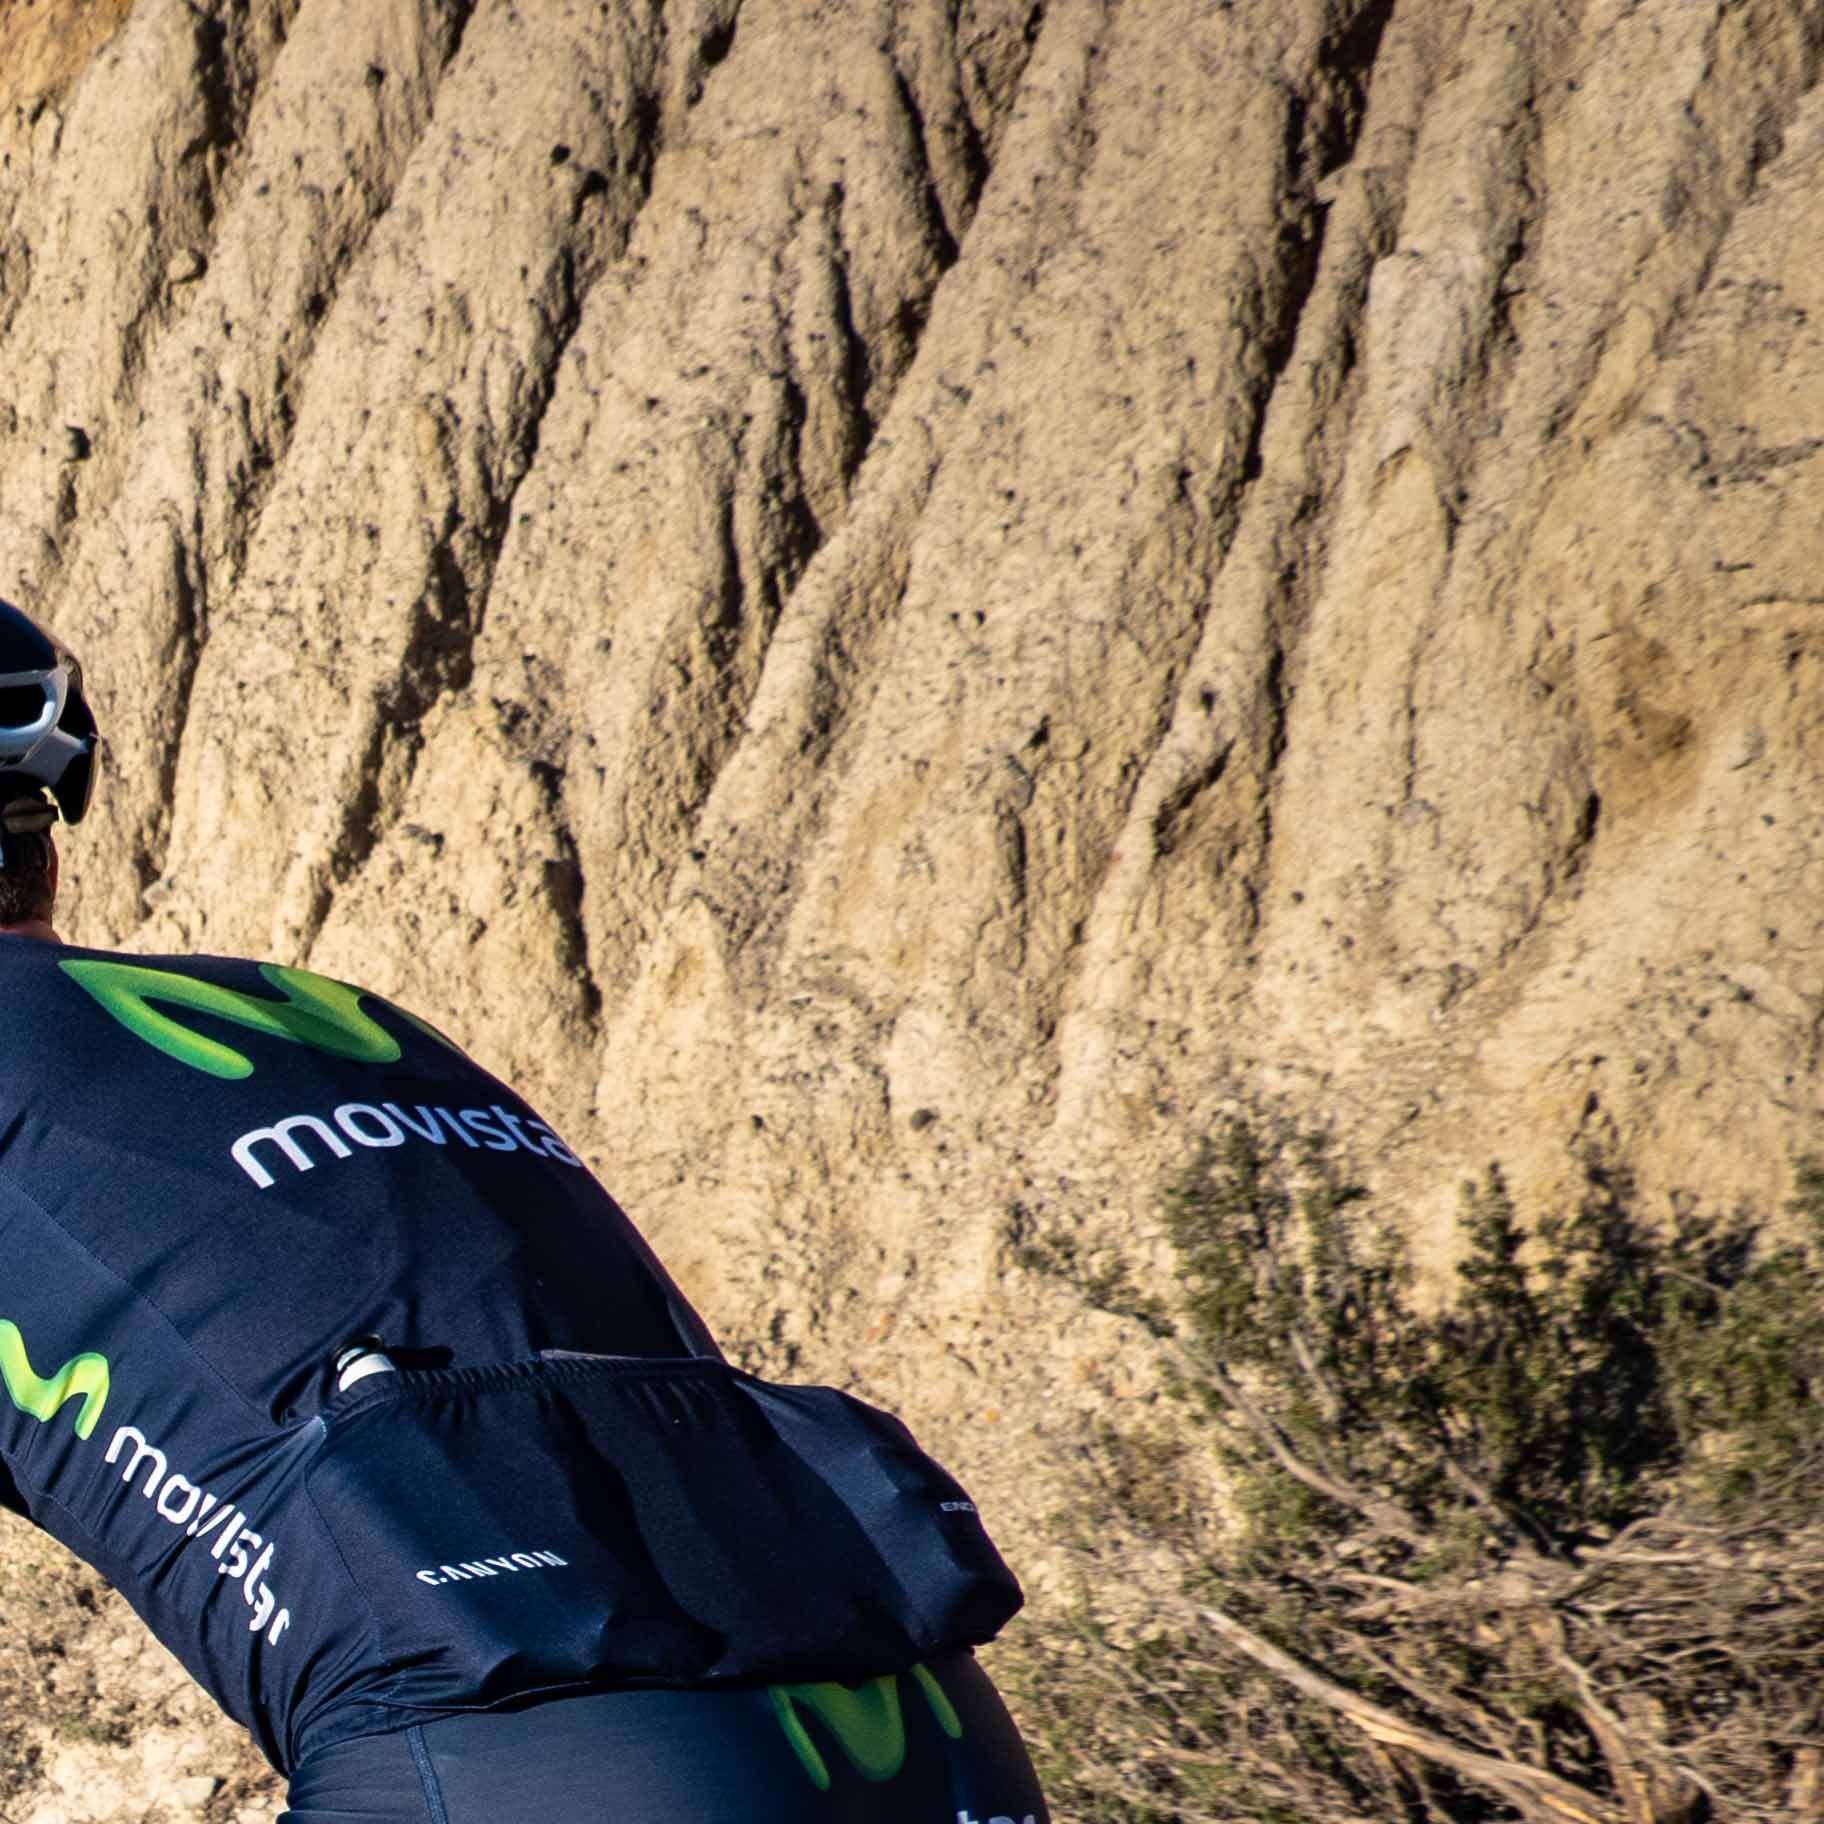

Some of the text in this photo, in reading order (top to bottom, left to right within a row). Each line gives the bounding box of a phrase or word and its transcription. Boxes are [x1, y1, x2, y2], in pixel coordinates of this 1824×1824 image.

[230, 1102, 584, 1190] movista
[104, 1425, 292, 1646] movistar
[415, 1550, 569, 1586] CANYON
